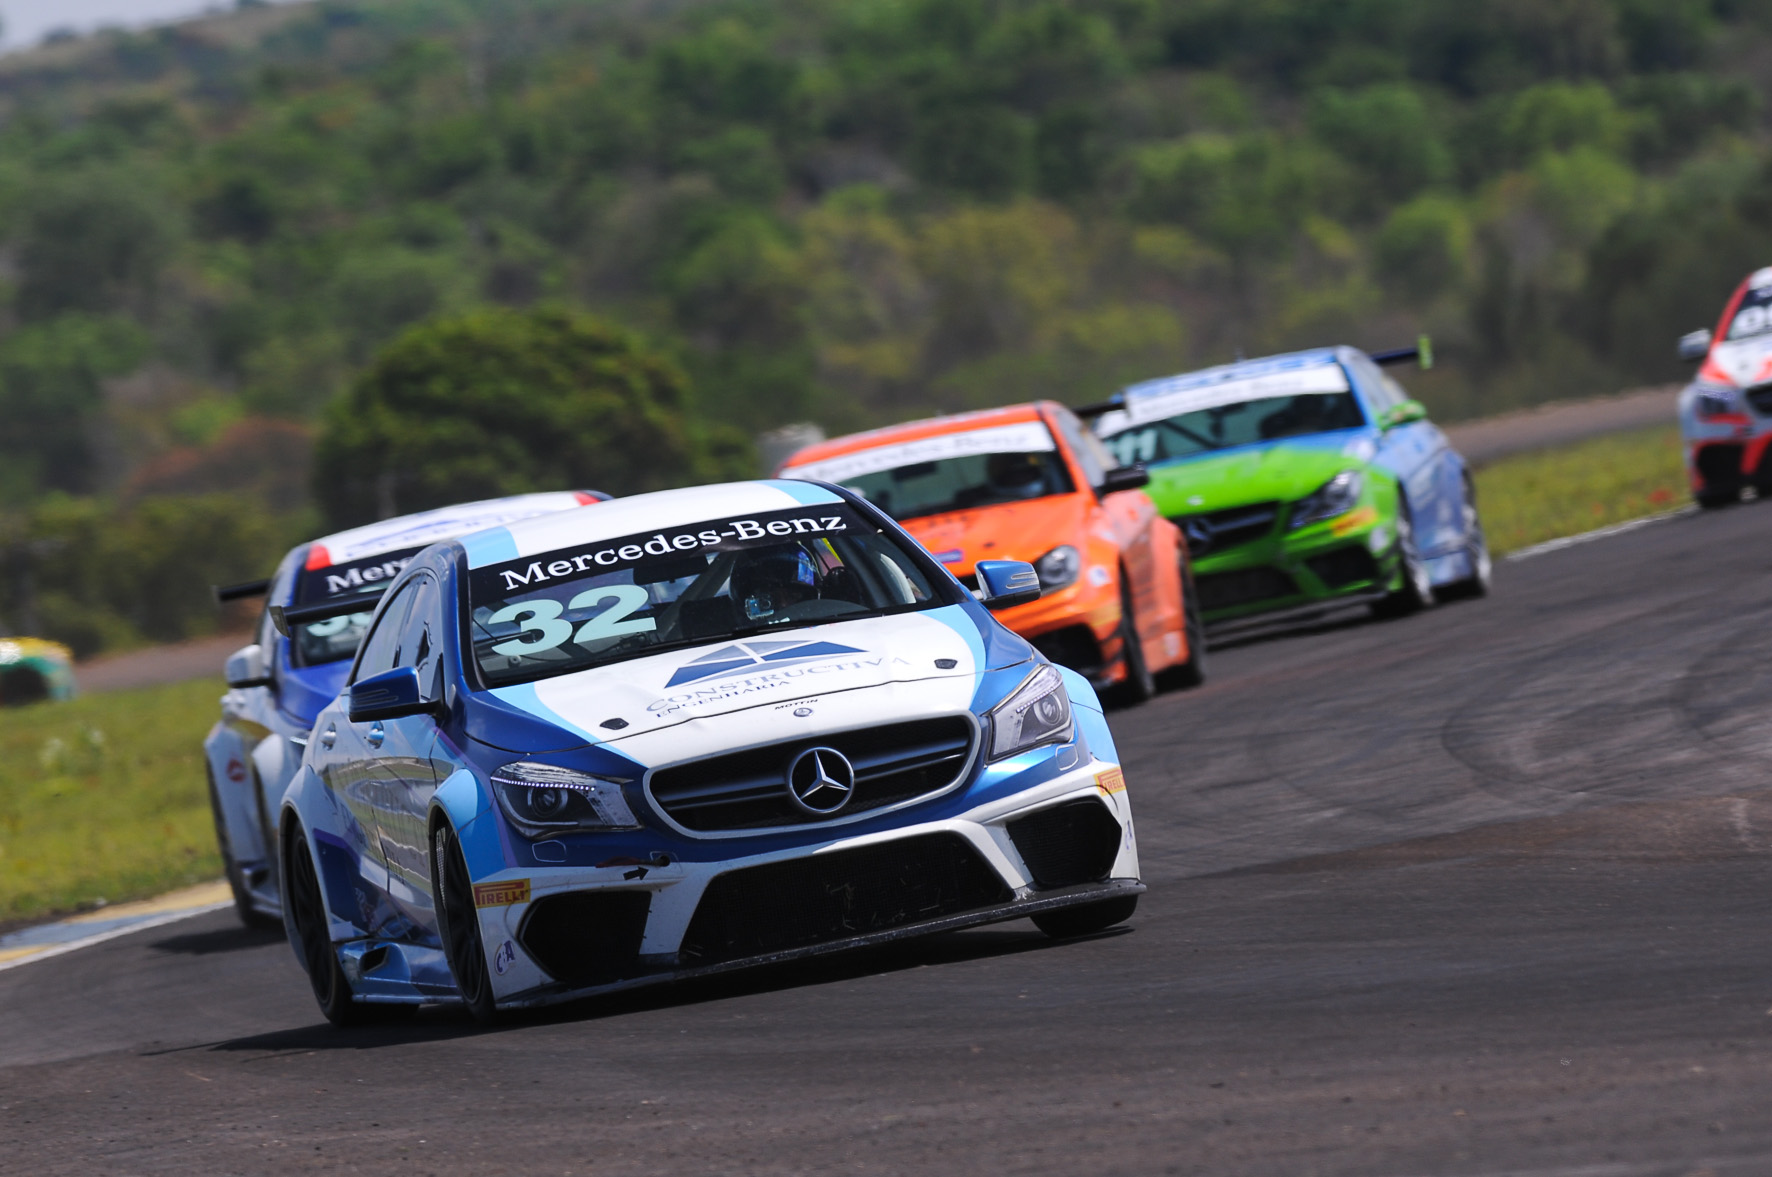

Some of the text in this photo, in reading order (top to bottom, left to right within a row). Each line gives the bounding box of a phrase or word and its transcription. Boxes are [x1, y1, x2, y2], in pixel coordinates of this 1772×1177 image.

[500, 516, 847, 590] Mercedes-Benz
[488, 584, 657, 656] 32
[646, 657, 911, 711] CONSTRUCTIVA
[657, 680, 790, 717] ENGENHARIA
[474, 881, 528, 906] PIRELLI
